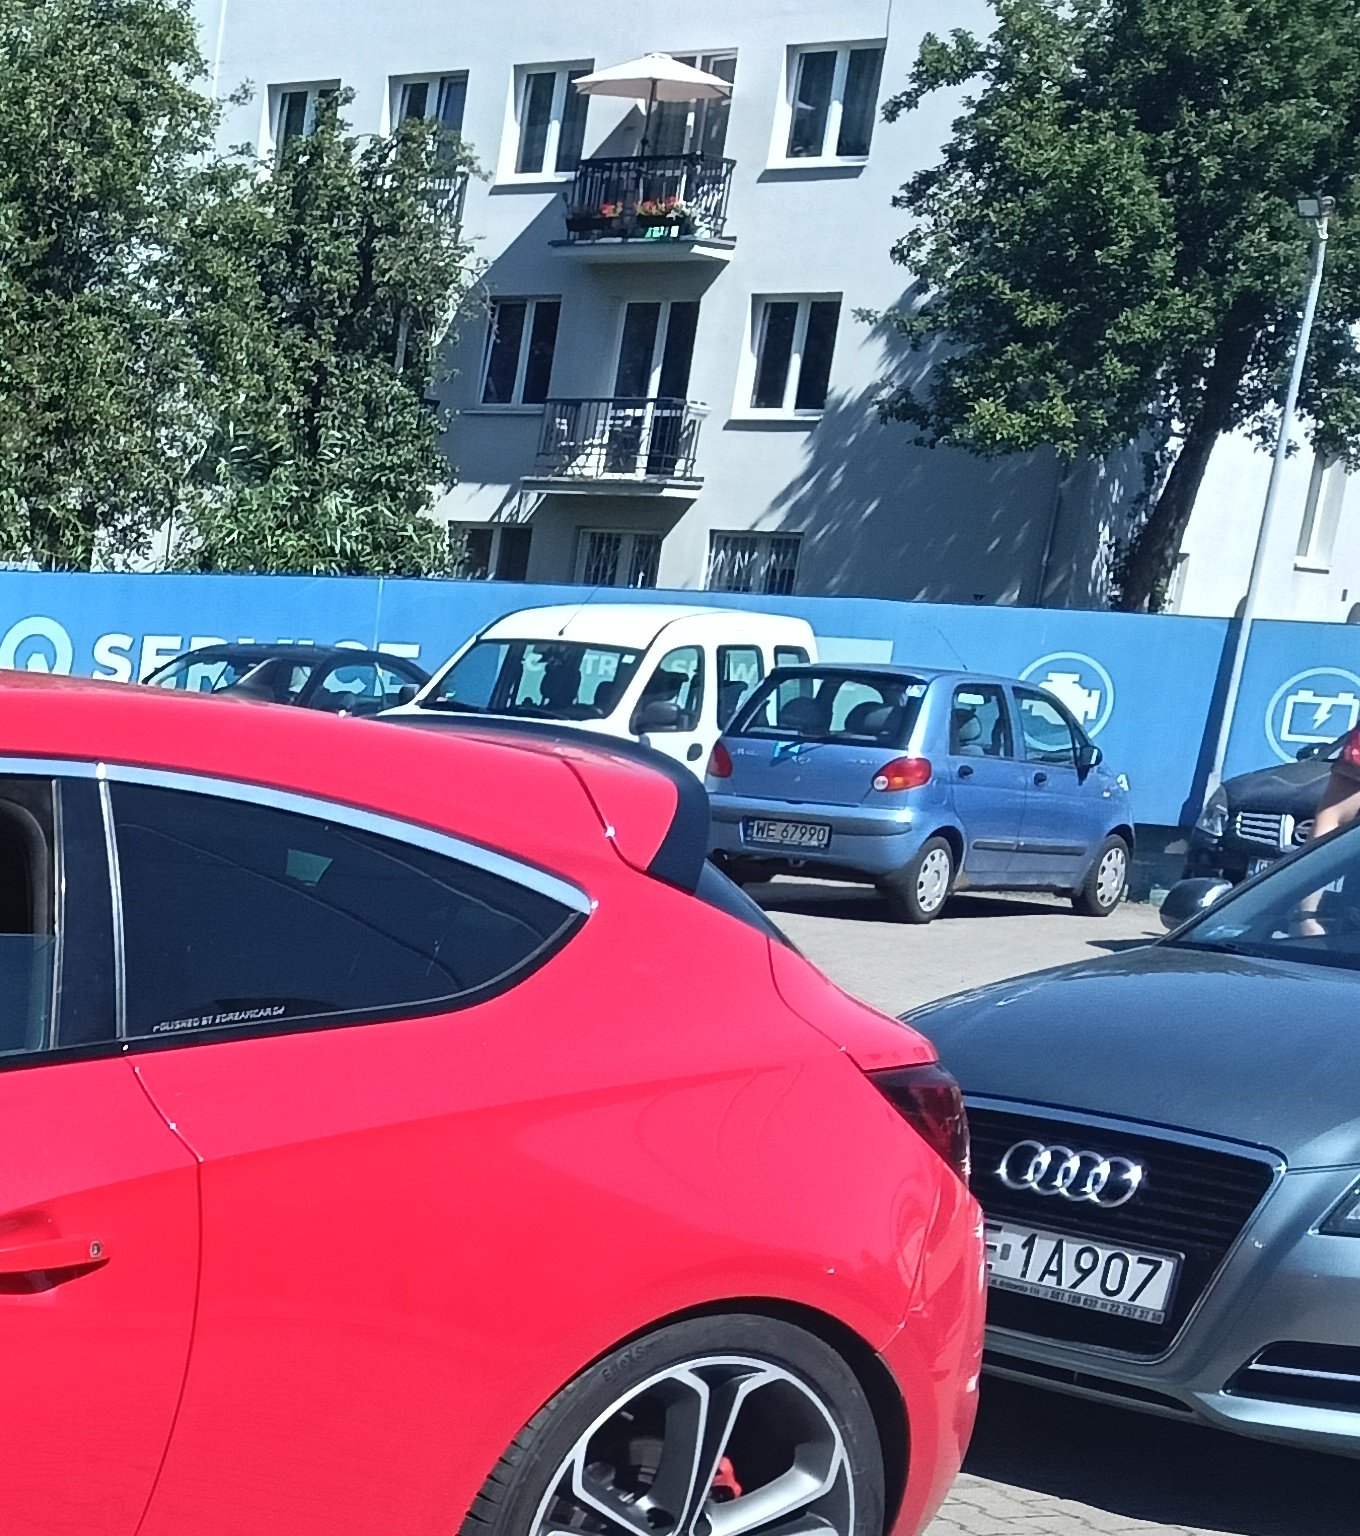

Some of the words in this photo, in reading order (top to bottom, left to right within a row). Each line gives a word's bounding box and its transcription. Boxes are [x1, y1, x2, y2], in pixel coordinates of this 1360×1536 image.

[754, 820, 777, 838] WE
[780, 823, 827, 842] 67990
[1020, 1233, 1163, 1303] 1A907
